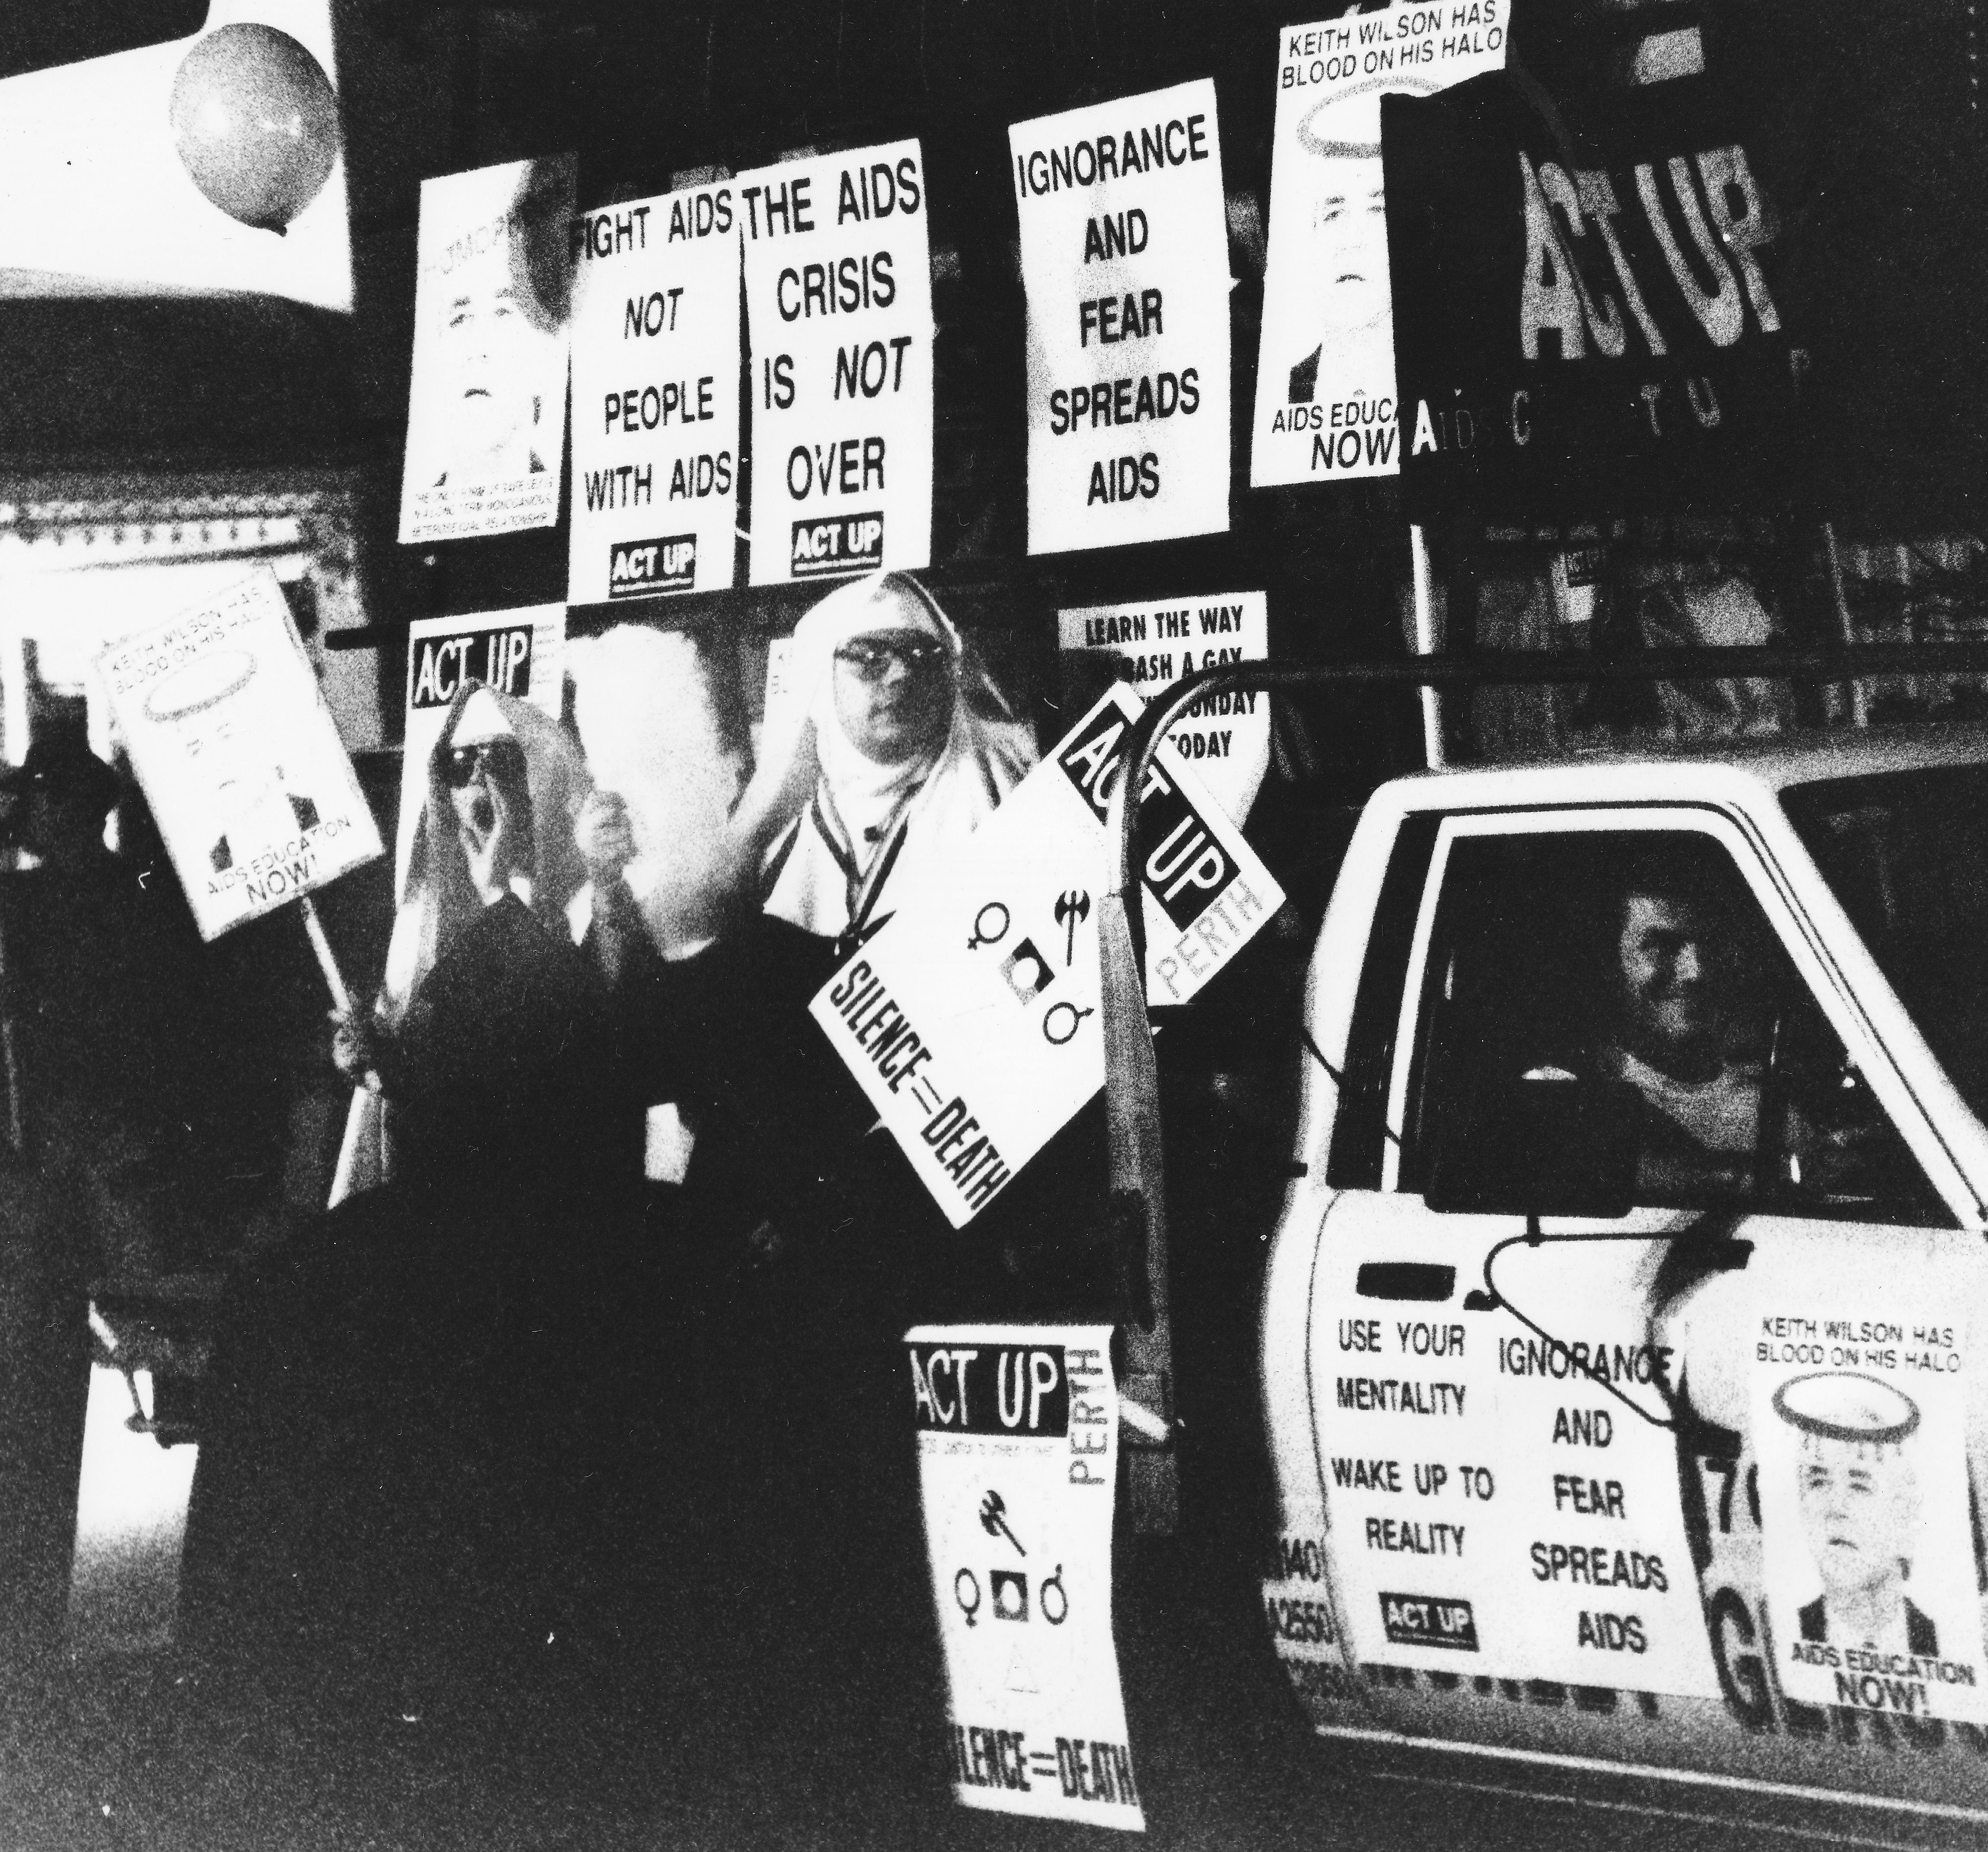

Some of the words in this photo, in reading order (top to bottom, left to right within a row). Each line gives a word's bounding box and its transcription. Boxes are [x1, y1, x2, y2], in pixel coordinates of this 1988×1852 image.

[1289, 26, 1350, 57] KEITH
[1359, 9, 1442, 46] WILSON
[1451, 0, 1496, 30] HAS
[1282, 53, 1356, 89] BLOOD
[1364, 46, 1394, 73] ON
[1400, 38, 1433, 67] HIS
[1442, 27, 1503, 59] HALO
[1018, 114, 1209, 197] IGNORANCE
[741, 178, 815, 240] THE
[838, 157, 921, 226] AIDS
[568, 206, 650, 260] FIGHT
[668, 189, 732, 243] AIDS
[1084, 208, 1149, 263] AND
[1519, 150, 1667, 359] ACT
[1634, 144, 1781, 347] UP
[778, 251, 896, 322] CRISIS
[625, 288, 683, 339] NOT
[1080, 288, 1163, 347] FEAR
[764, 354, 795, 409] IS
[835, 336, 912, 401] NOT
[605, 376, 713, 435] PEOPLE
[1051, 368, 1200, 435] SPREADS
[1272, 402, 1323, 434] AIDS
[1330, 397, 1397, 428] EDUC
[787, 437, 885, 500] OVER
[1311, 426, 1396, 470] NOW
[585, 463, 652, 512] WITH
[669, 451, 732, 502] AIDS
[1087, 452, 1160, 506] AIDS
[612, 547, 659, 583] ACT
[662, 542, 694, 572] UP
[793, 524, 840, 560] ACT
[847, 520, 881, 553] UP
[1087, 614, 1146, 646] LEARN
[1154, 610, 1190, 639] THE
[1198, 605, 1243, 635] WAY
[416, 636, 475, 702] ACT
[487, 631, 528, 692] UP
[1181, 652, 1194, 679] A
[1176, 691, 1256, 718] UNDAY
[207, 869, 246, 896] AIDS
[251, 815, 352, 874] EDUCATION
[246, 855, 317, 905] NOW!
[1146, 815, 1225, 902] UP
[1156, 878, 1263, 999] PERTH
[1339, 1319, 1382, 1353] USE
[1397, 1322, 1466, 1357] YOUR
[1757, 1343, 1825, 1364] BLOOD
[1831, 1347, 1858, 1367] ON
[1865, 1349, 1897, 1369] HIS
[1905, 1352, 1961, 1373] HALO
[1762, 1317, 1816, 1339] KEITH
[1824, 1320, 1903, 1344] WILSON
[1913, 1325, 1954, 1349] HAS
[1499, 1337, 1675, 1385] IGNORANCE
[909, 1349, 977, 1426] ACT
[998, 1351, 1058, 1429] UP
[1336, 1377, 1466, 1416] MENTALITY
[1065, 1349, 1108, 1485] PERTH
[1553, 1407, 1613, 1448] AND
[1332, 1458, 1402, 1492] WAKE
[1414, 1463, 1448, 1496] UP
[1459, 1466, 1495, 1500] TO
[1553, 1474, 1626, 1520] FEAR
[1366, 1517, 1465, 1556] REALITY
[1530, 1542, 1669, 1593] SPREADS
[1387, 1601, 1430, 1629] ACT
[1438, 1606, 1470, 1634] UP
[1577, 1610, 1648, 1654] AIDS
[1792, 1643, 1842, 1669] AIDS
[1846, 1649, 1975, 1686] EDUCATION
[1835, 1670, 1930, 1716] NOW!
